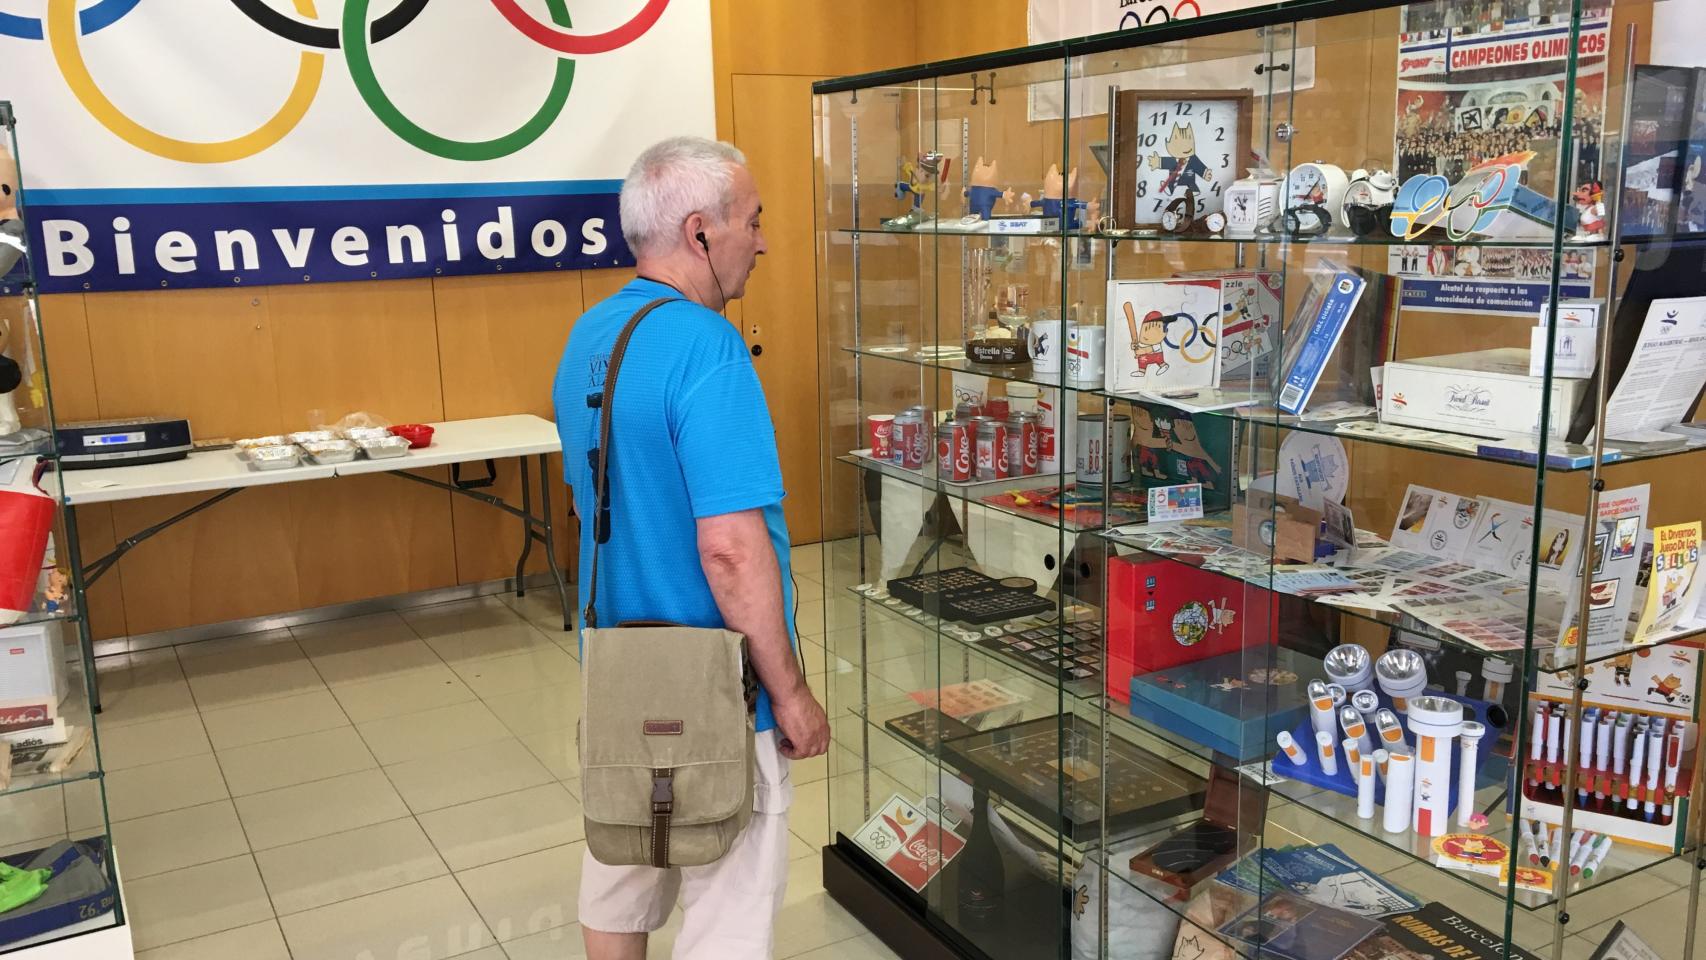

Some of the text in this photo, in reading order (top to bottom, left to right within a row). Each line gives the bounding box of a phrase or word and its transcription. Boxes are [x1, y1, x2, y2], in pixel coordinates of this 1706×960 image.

[1452, 43, 1528, 69] CAMPEONES
[1175, 102, 1193, 116] 12
[1200, 108, 1211, 125] 1
[1149, 111, 1168, 126] 11
[1137, 133, 1157, 147] 10
[1215, 127, 1225, 142] 2
[1221, 153, 1230, 168] 3
[1136, 180, 1147, 198] 8
[1211, 181, 1221, 197] 4
[1153, 197, 1163, 212] 7
[1196, 197, 1206, 213] 5
[42, 205, 606, 277] Bienvenidos
[1475, 285, 1509, 296] respuesta
[1517, 284, 1528, 295] las
[1434, 295, 1475, 305] necesidades
[1486, 297, 1533, 308] comunicación
[974, 346, 1001, 355] Estrella
[956, 436, 970, 473] Coke
[1025, 430, 1038, 469] Coke
[1656, 547, 1698, 572] SELLOS
[1392, 914, 1473, 958] RUMBAS DE
